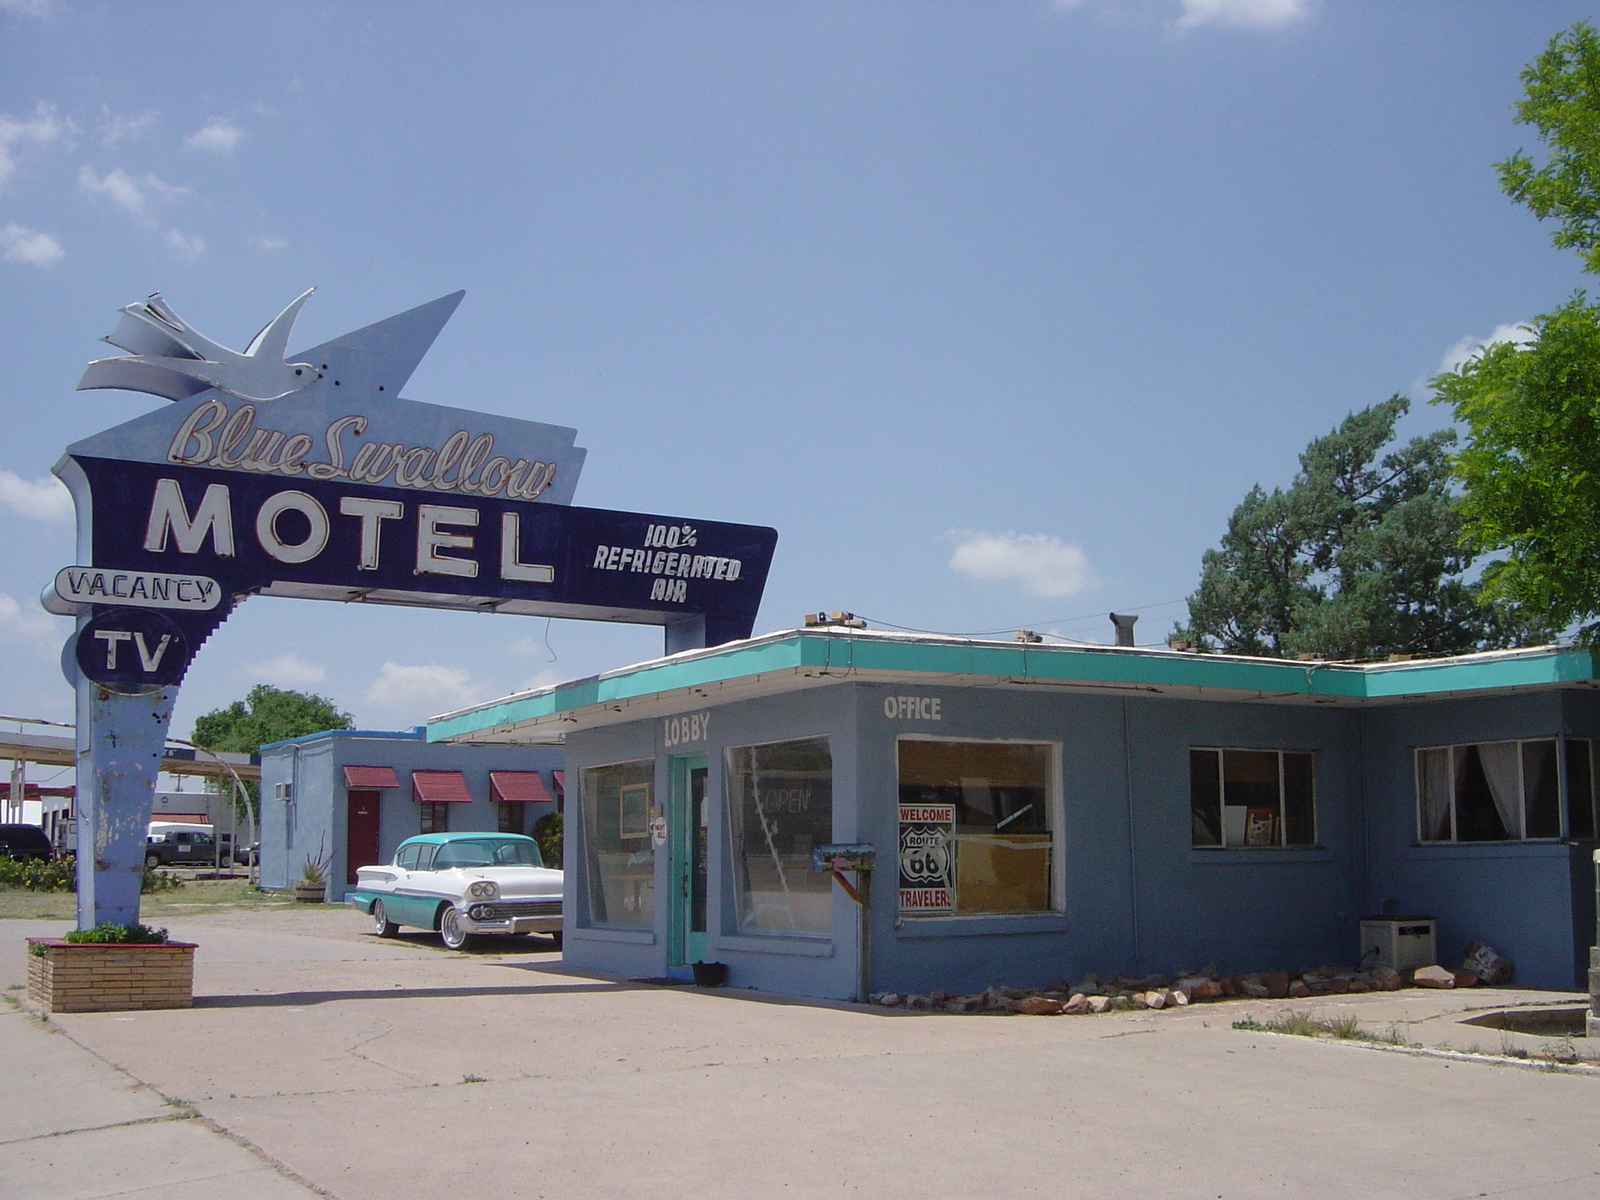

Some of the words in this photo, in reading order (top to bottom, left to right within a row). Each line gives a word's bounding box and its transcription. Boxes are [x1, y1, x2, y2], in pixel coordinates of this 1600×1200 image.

[166, 399, 313, 475] Blue
[307, 415, 556, 500] Swallow
[143, 478, 555, 583] MOTEL
[643, 524, 697, 548] 100%
[593, 545, 742, 581] REFRIGERATED
[67, 570, 214, 603] VACANCY
[650, 578, 688, 603] AIR
[94, 629, 172, 672] TV
[884, 697, 941, 720] OFFICE
[664, 711, 710, 747] LOBBY
[765, 788, 811, 813] OPEN
[900, 808, 951, 821] WELCOME
[909, 836, 940, 846] ROUTE
[910, 849, 940, 875] 66
